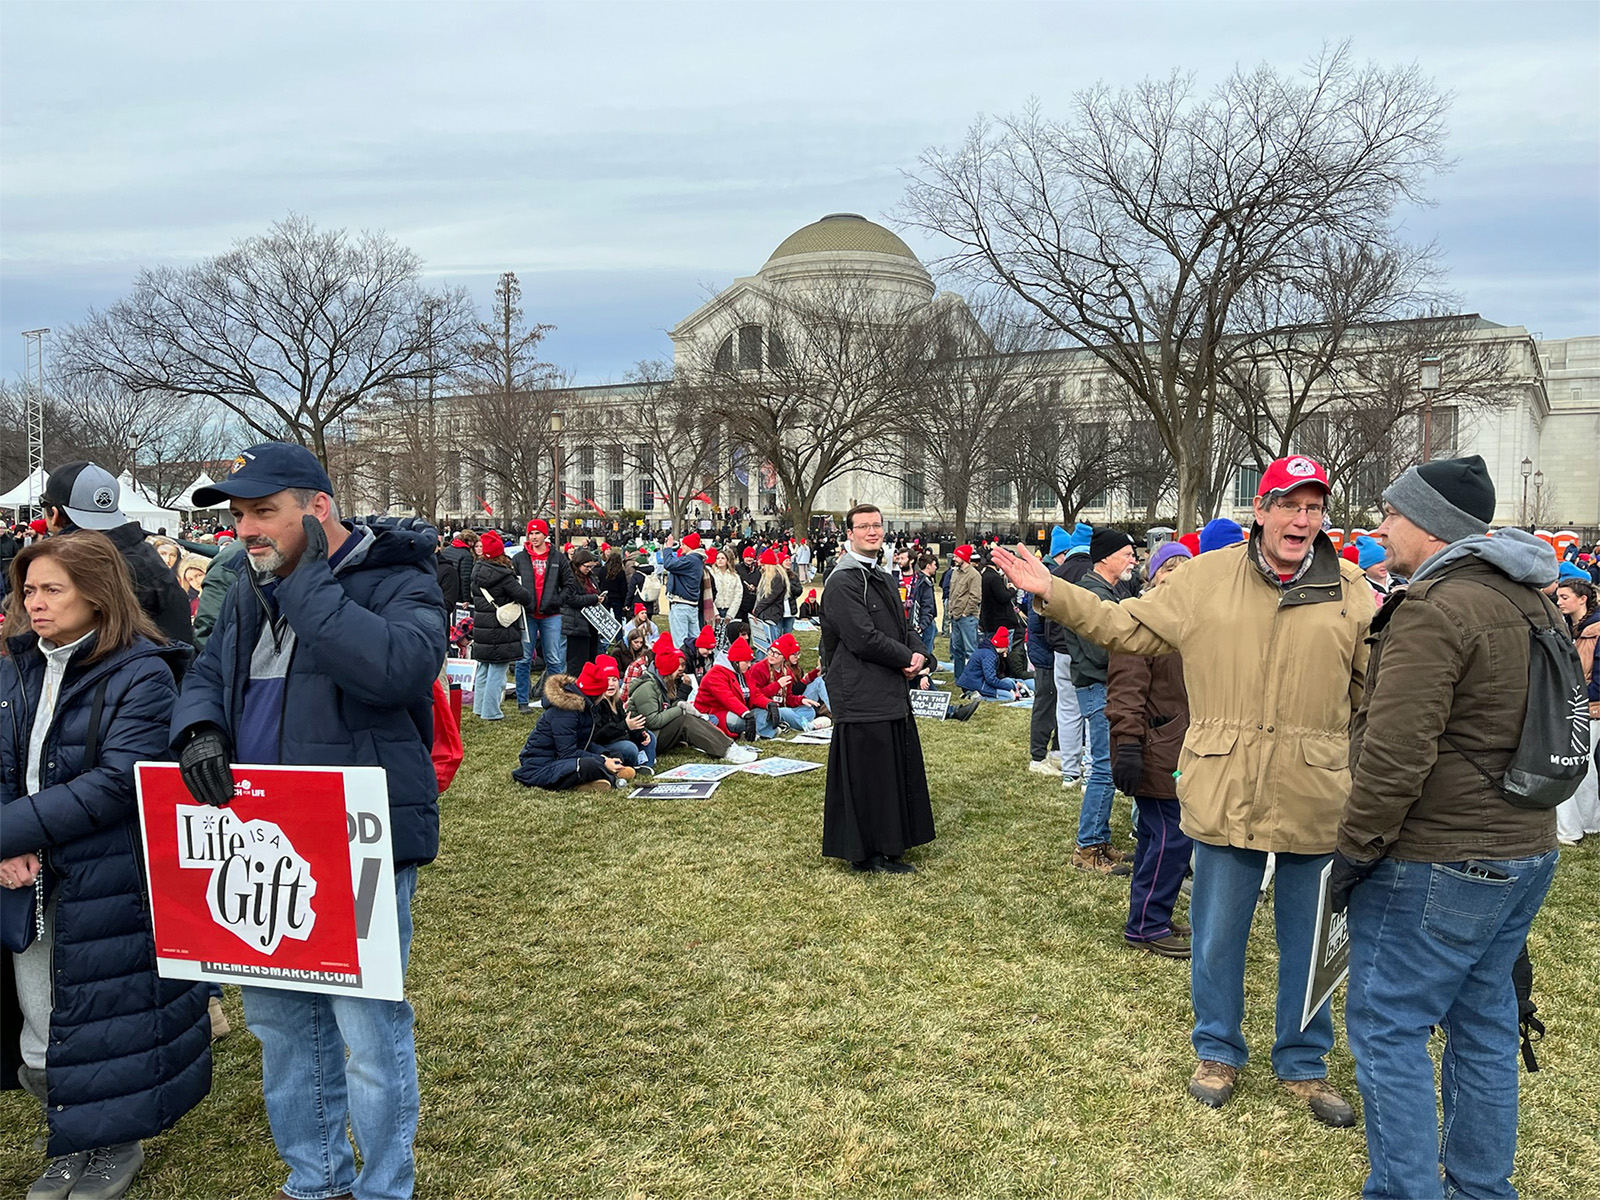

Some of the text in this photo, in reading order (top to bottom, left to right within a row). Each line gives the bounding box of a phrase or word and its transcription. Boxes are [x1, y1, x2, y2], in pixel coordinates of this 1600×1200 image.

[251, 789, 265, 797] LIFE
[182, 815, 281, 861] Life IS A
[217, 854, 307, 947] Gift
